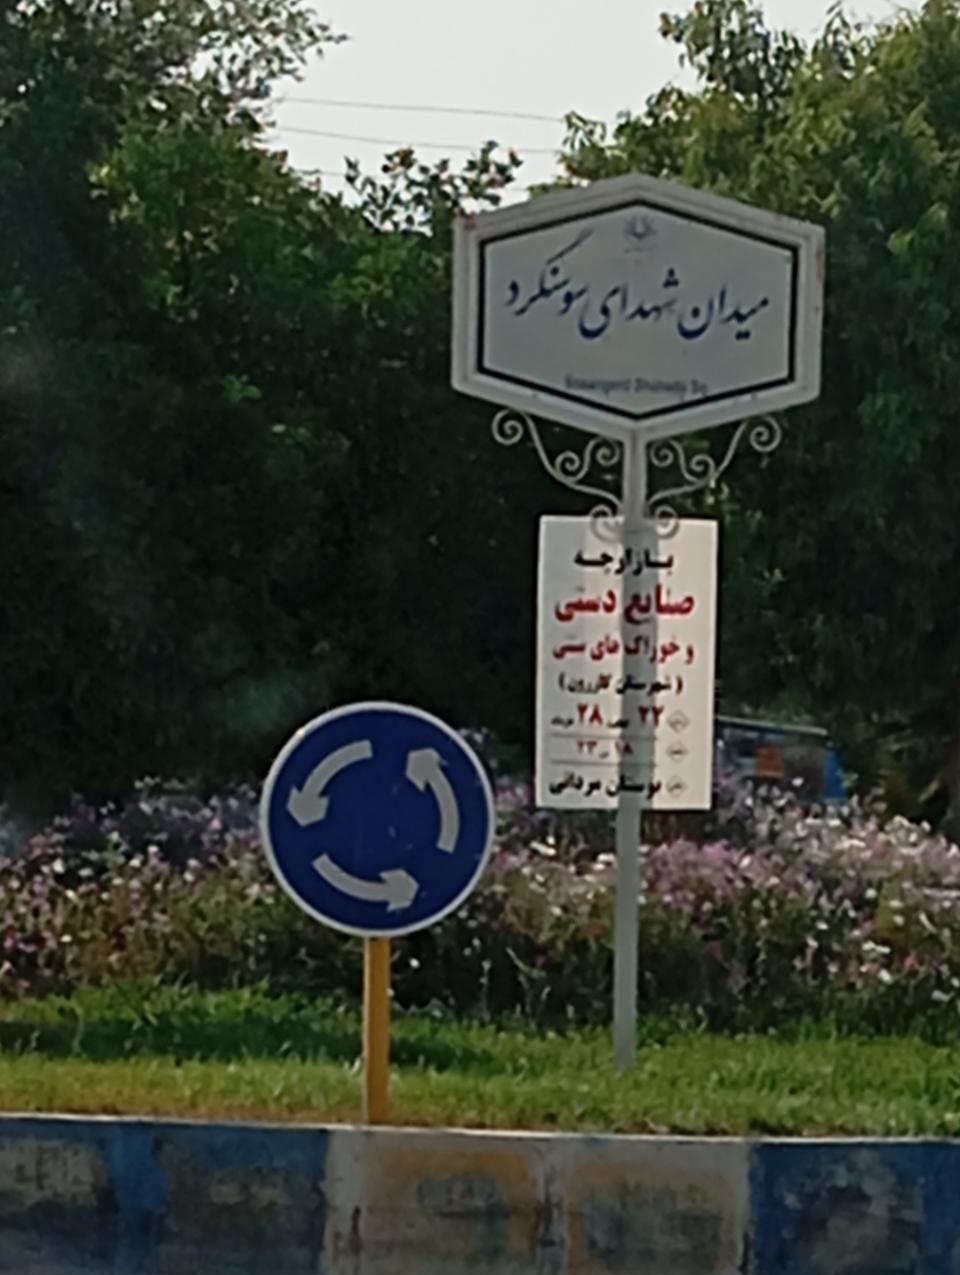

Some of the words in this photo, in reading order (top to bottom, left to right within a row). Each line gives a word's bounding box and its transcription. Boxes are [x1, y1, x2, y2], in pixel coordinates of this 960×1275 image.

[503, 228, 596, 317] سوسنگرد
[577, 267, 680, 340] شهدای
[677, 283, 769, 341] میدان
[574, 548, 674, 576] بازارچه
[555, 585, 617, 623] دستی
[624, 583, 695, 625] صنایع
[590, 633, 620, 661] های
[624, 634, 680, 663] خوراک
[685, 645, 695, 665] و
